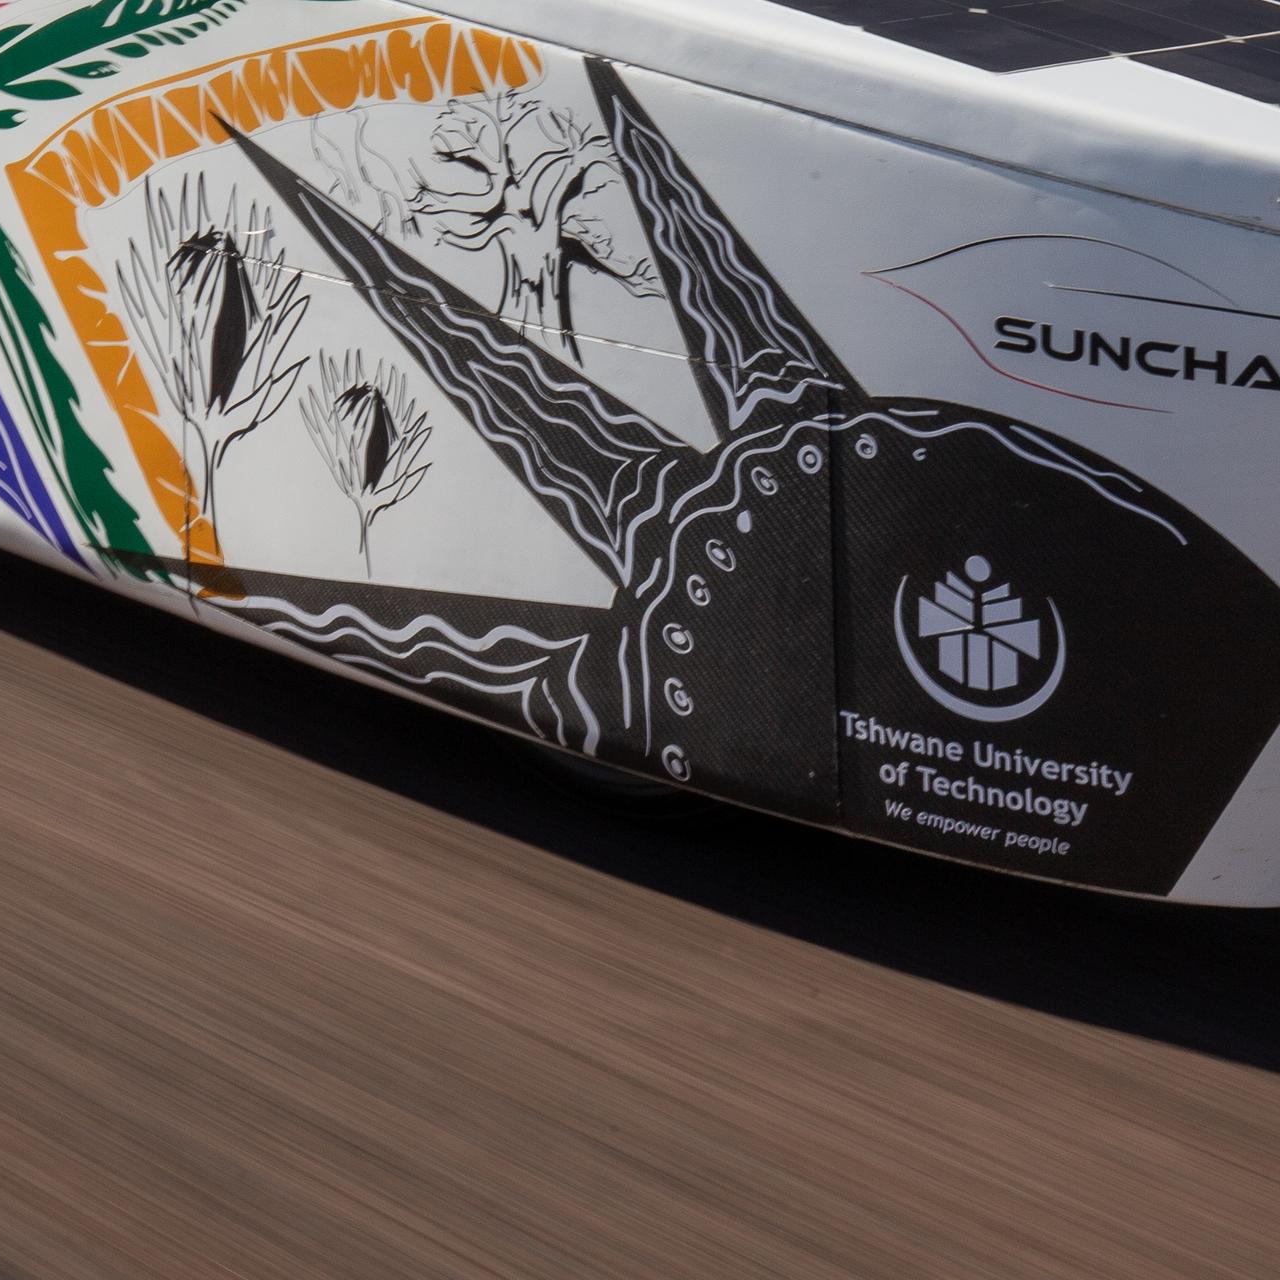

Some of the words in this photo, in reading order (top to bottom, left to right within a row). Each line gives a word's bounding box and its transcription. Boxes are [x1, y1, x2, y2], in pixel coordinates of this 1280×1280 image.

[840, 710, 964, 762] Tshwane
[973, 740, 1133, 796] University
[879, 762, 908, 787] of
[915, 765, 1088, 826] Technology
[885, 799, 912, 822] We
[916, 811, 1001, 841] empower
[1005, 830, 1071, 856] people
